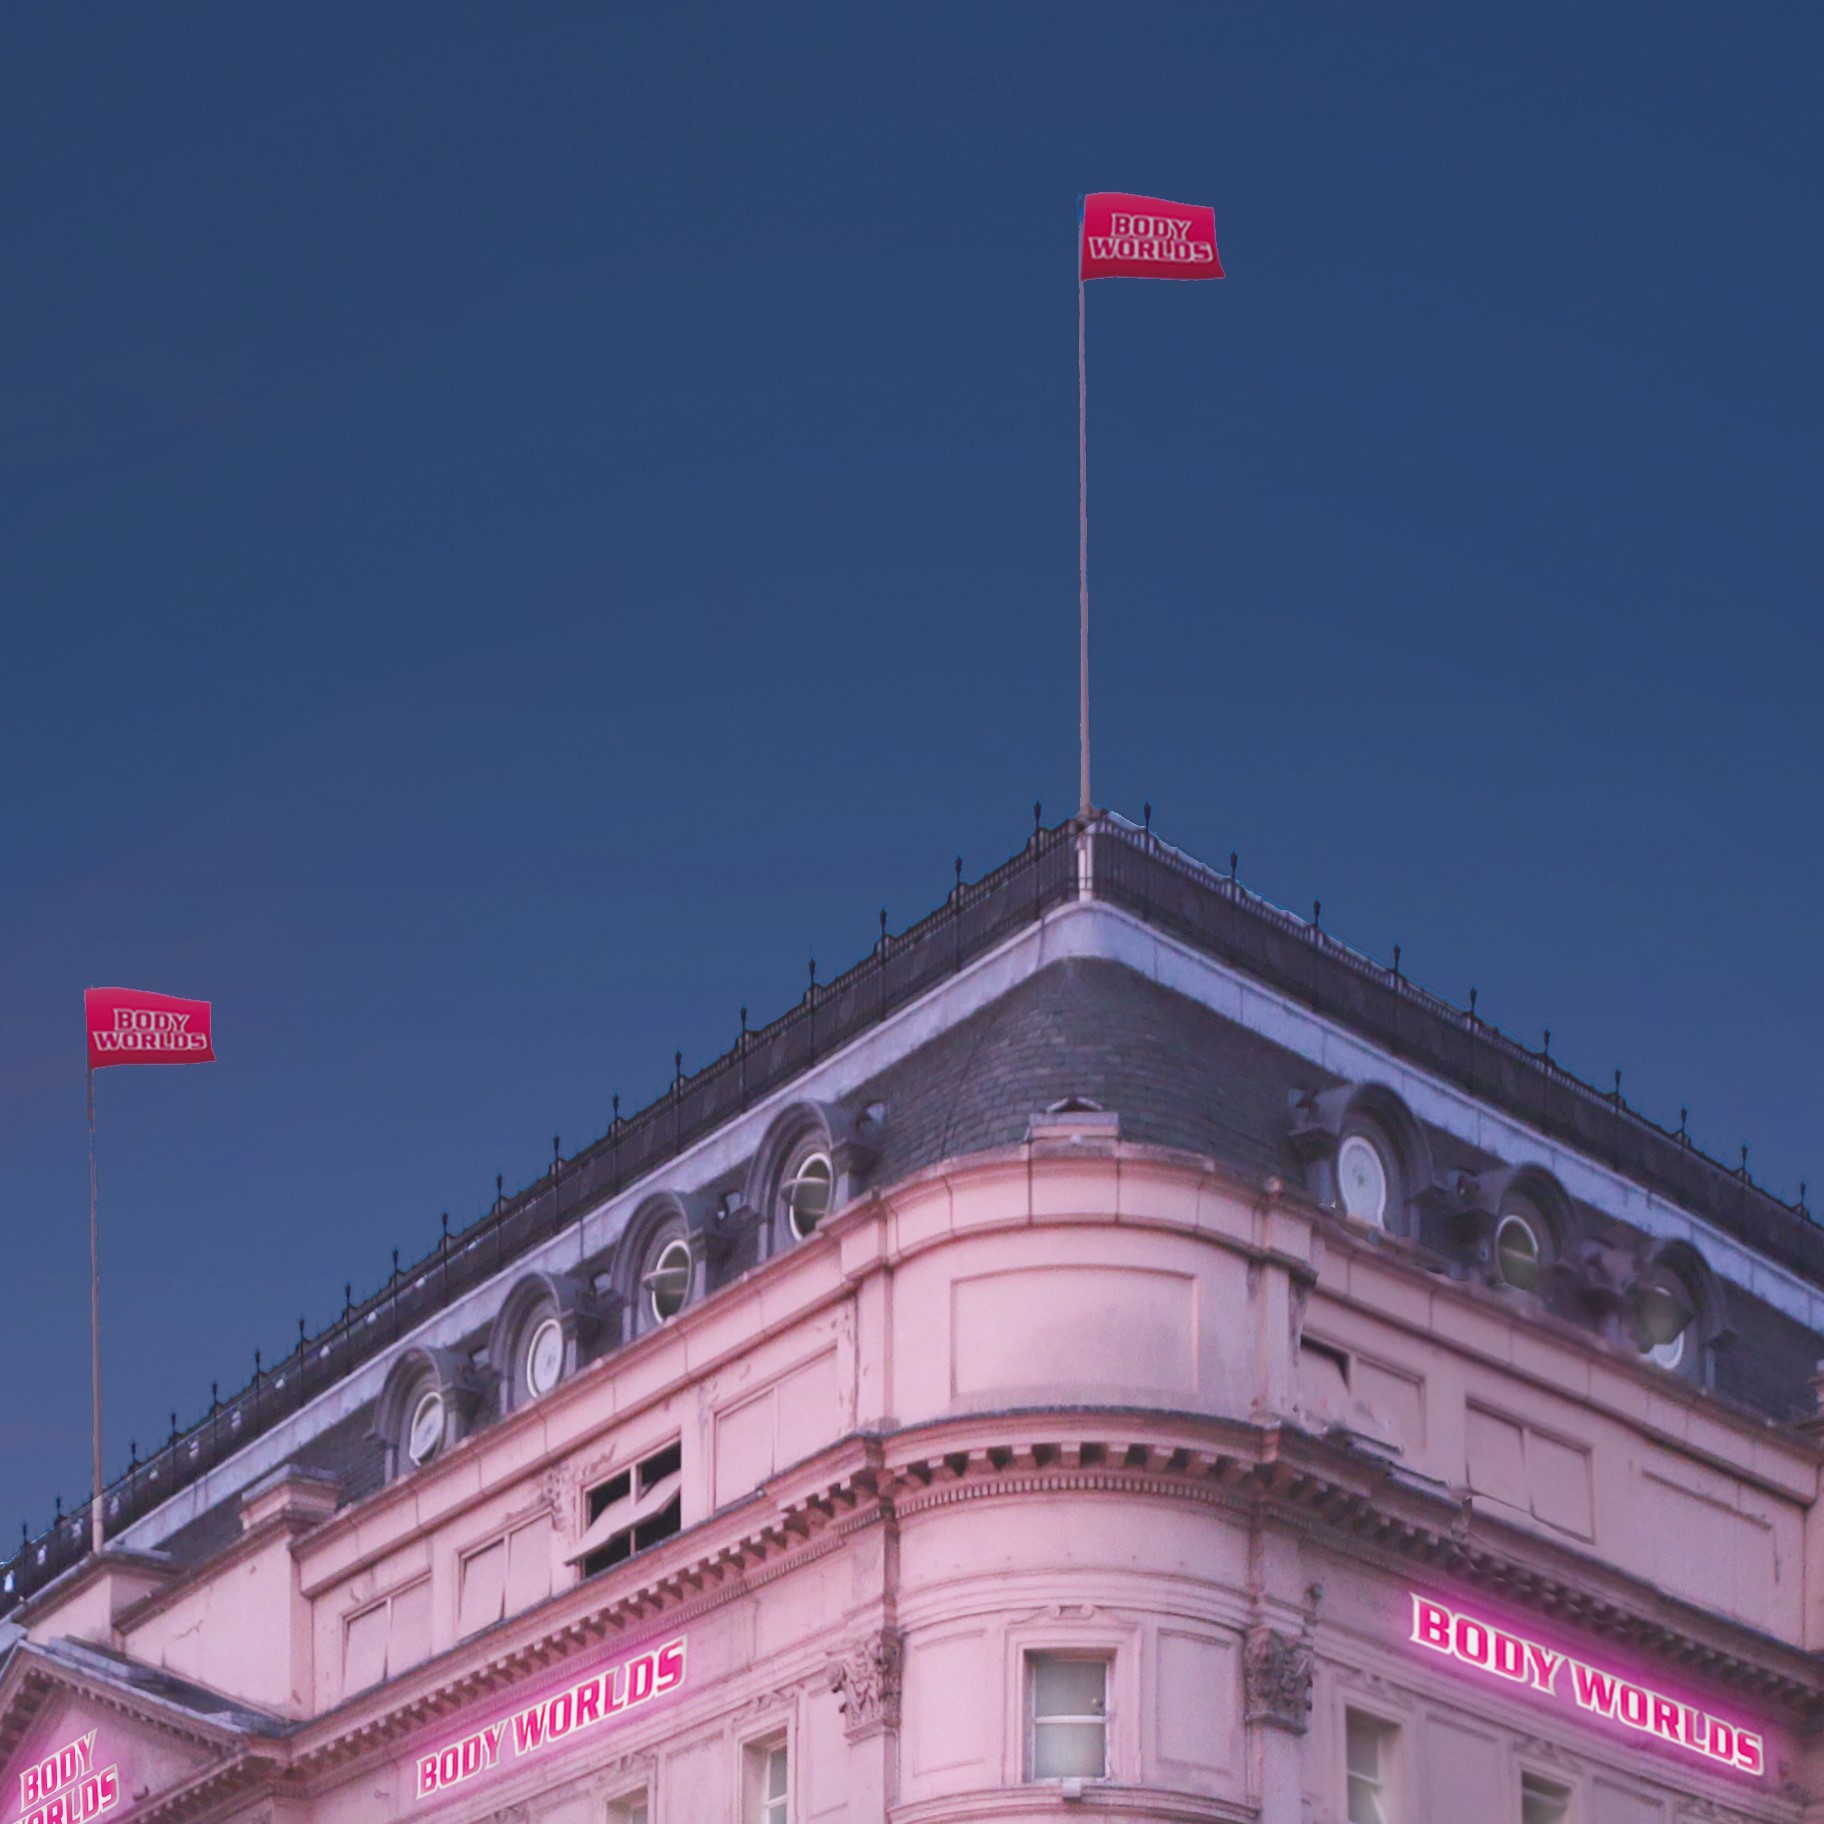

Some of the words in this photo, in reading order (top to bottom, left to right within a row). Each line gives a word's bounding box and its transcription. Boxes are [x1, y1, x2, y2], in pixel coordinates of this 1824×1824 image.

[1111, 213, 1192, 240] BODY
[1088, 236, 1214, 263] WORLDS
[113, 1008, 190, 1032] BODY
[93, 1031, 207, 1051] WORLDS
[1410, 1592, 1568, 1697] BODY
[1567, 1657, 1764, 1776] WORLDS
[416, 1718, 509, 1800] BODY
[512, 1634, 687, 1758] WORLDS
[19, 1728, 98, 1813] BODY
